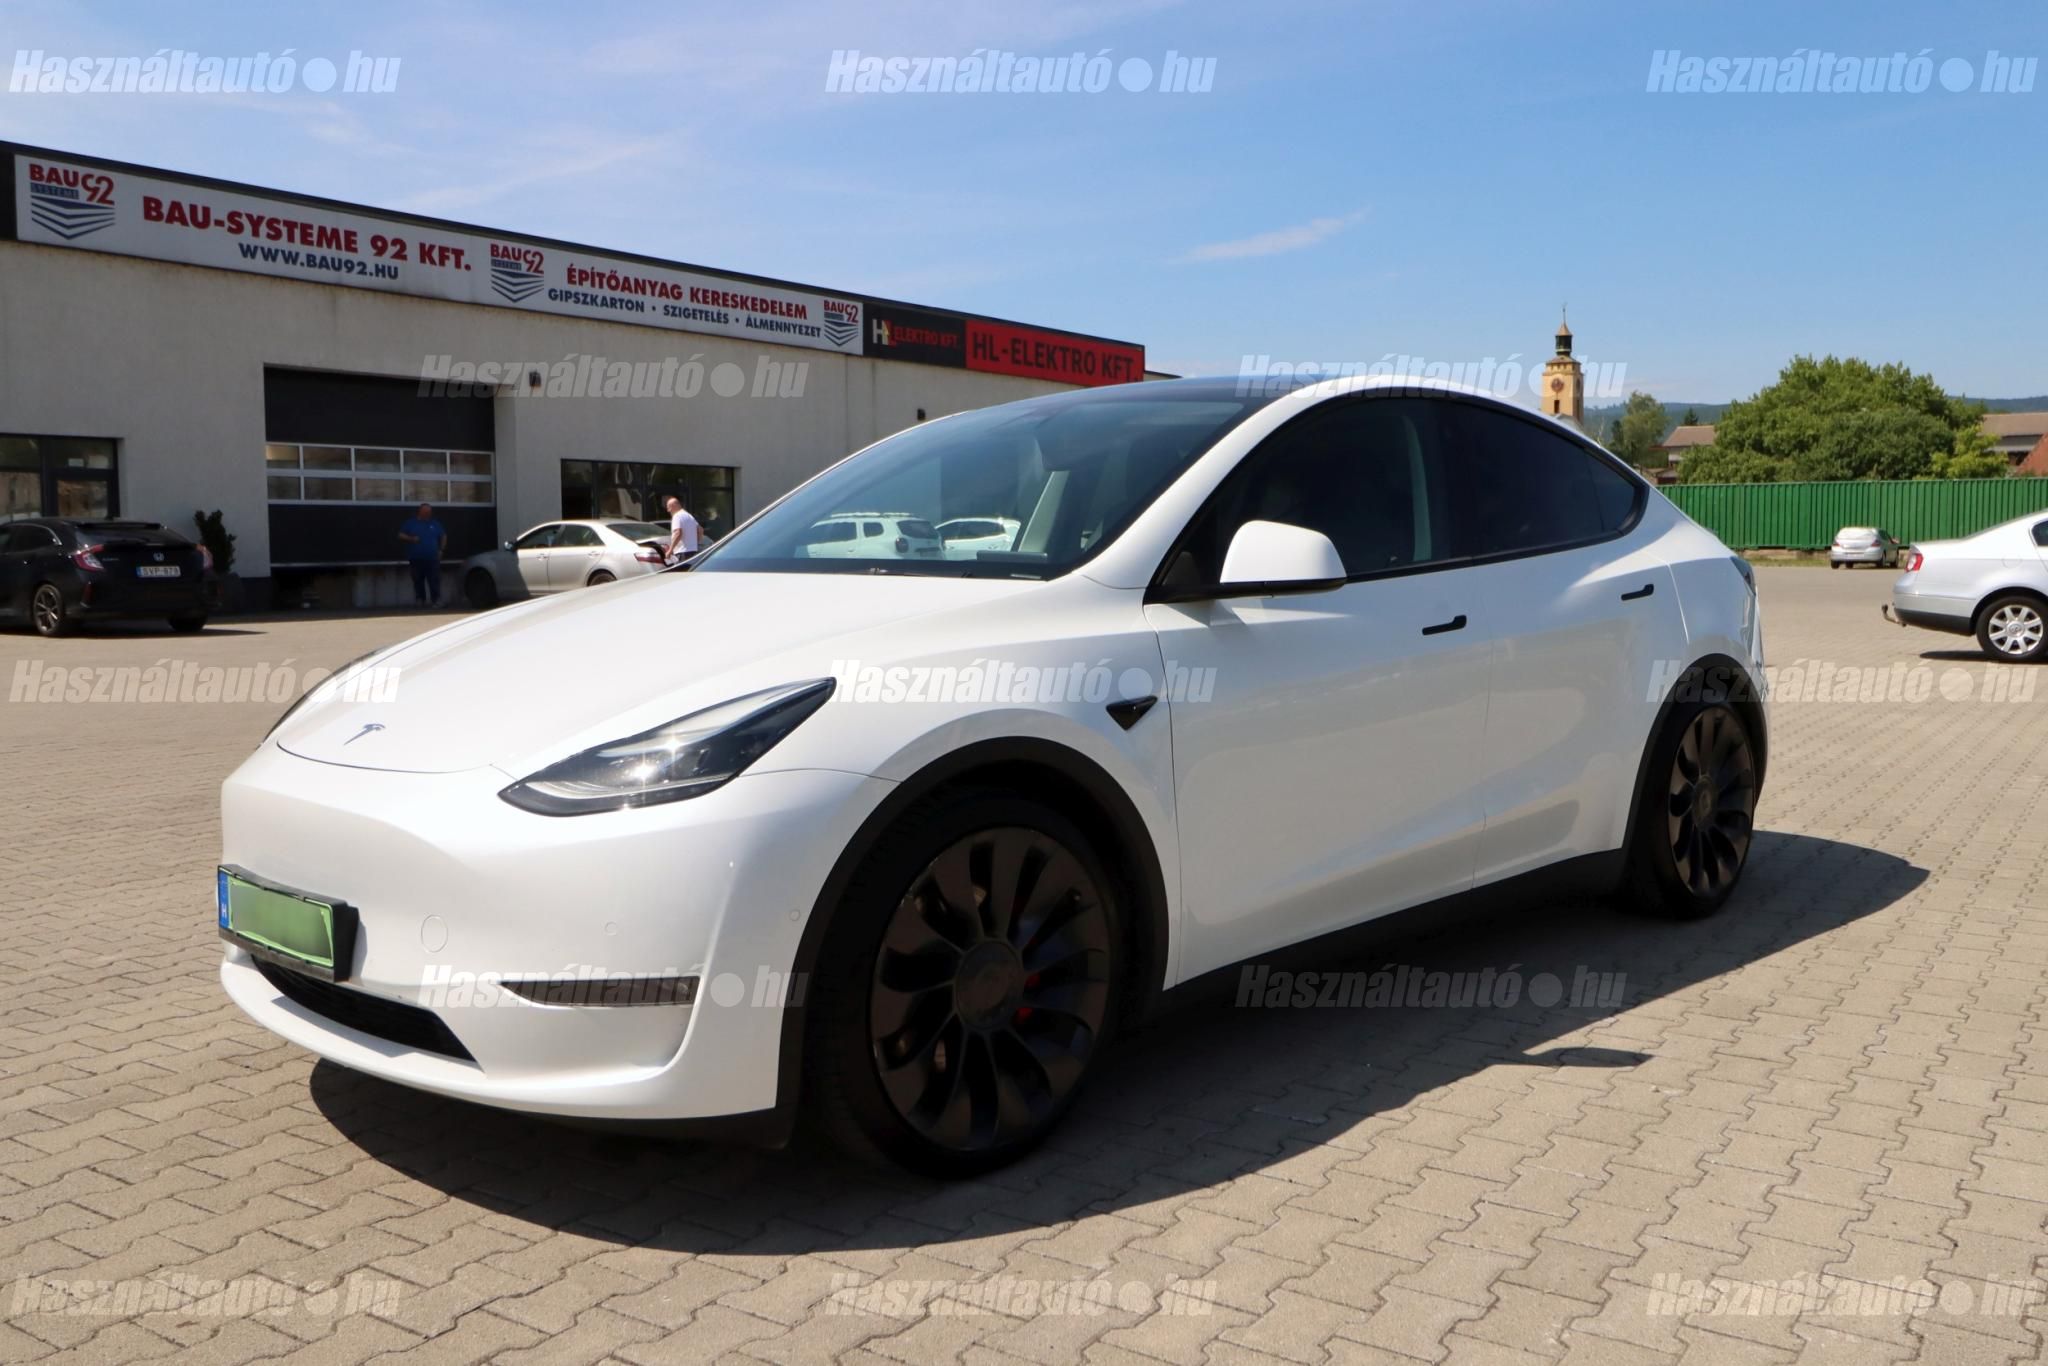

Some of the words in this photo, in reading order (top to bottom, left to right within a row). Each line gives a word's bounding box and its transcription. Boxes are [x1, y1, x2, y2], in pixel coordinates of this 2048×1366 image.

[143, 196, 357, 253] BAU-SYSTEME
[370, 235, 407, 261] 92
[419, 242, 471, 271] KFT.
[238, 242, 399, 280] WWW.BAU92.HU
[548, 288, 644, 312] GIPSZKARTON
[663, 304, 729, 325] SZIGETELÉS
[745, 314, 821, 338] ÁLMENNYEZET
[567, 264, 683, 300] ÉPÍTŐANYAG
[690, 286, 807, 320] KERESKEDELEM
[895, 326, 937, 345] ELEKTRO
[973, 331, 1096, 373] HL-ELEKTRO
